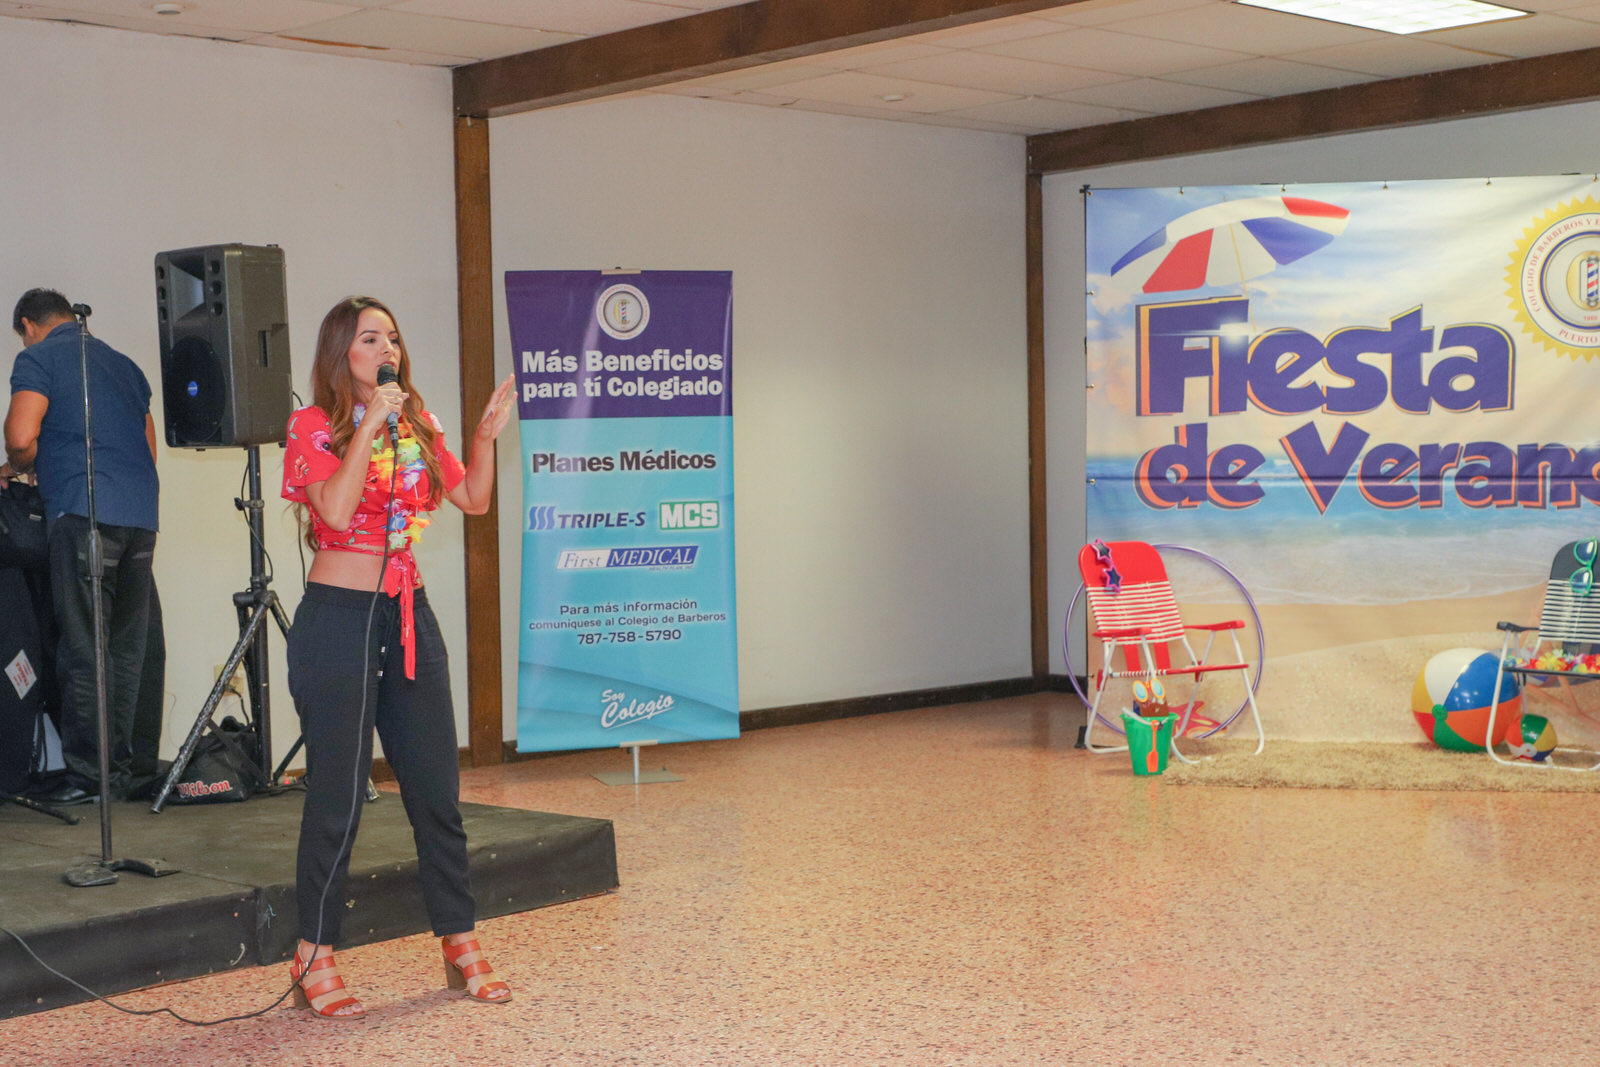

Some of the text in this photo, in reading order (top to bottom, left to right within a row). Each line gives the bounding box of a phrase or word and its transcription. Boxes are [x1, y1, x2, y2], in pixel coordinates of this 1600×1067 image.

[1527, 268, 1542, 313] COLEGIO
[1559, 328, 1599, 344] PUERTO
[522, 349, 724, 373] Más Beneficios
[1135, 295, 1516, 417] Fiesta
[523, 375, 723, 402] para tí Colegiado
[532, 448, 717, 474] Planes Médicos
[1134, 421, 1267, 511] de
[557, 511, 647, 529] TRIPLE-S
[660, 502, 719, 529] MCS
[563, 548, 693, 568] First MEDICAL
[560, 598, 698, 615] Para más información
[605, 617, 615, 626] al
[618, 615, 659, 628] Colegio
[661, 614, 674, 625] de
[677, 612, 726, 624] Barberos
[577, 629, 682, 645] 787-758-5790
[601, 689, 625, 703] Soy
[601, 694, 675, 728] Colegio
[176, 780, 232, 798] Wilson
